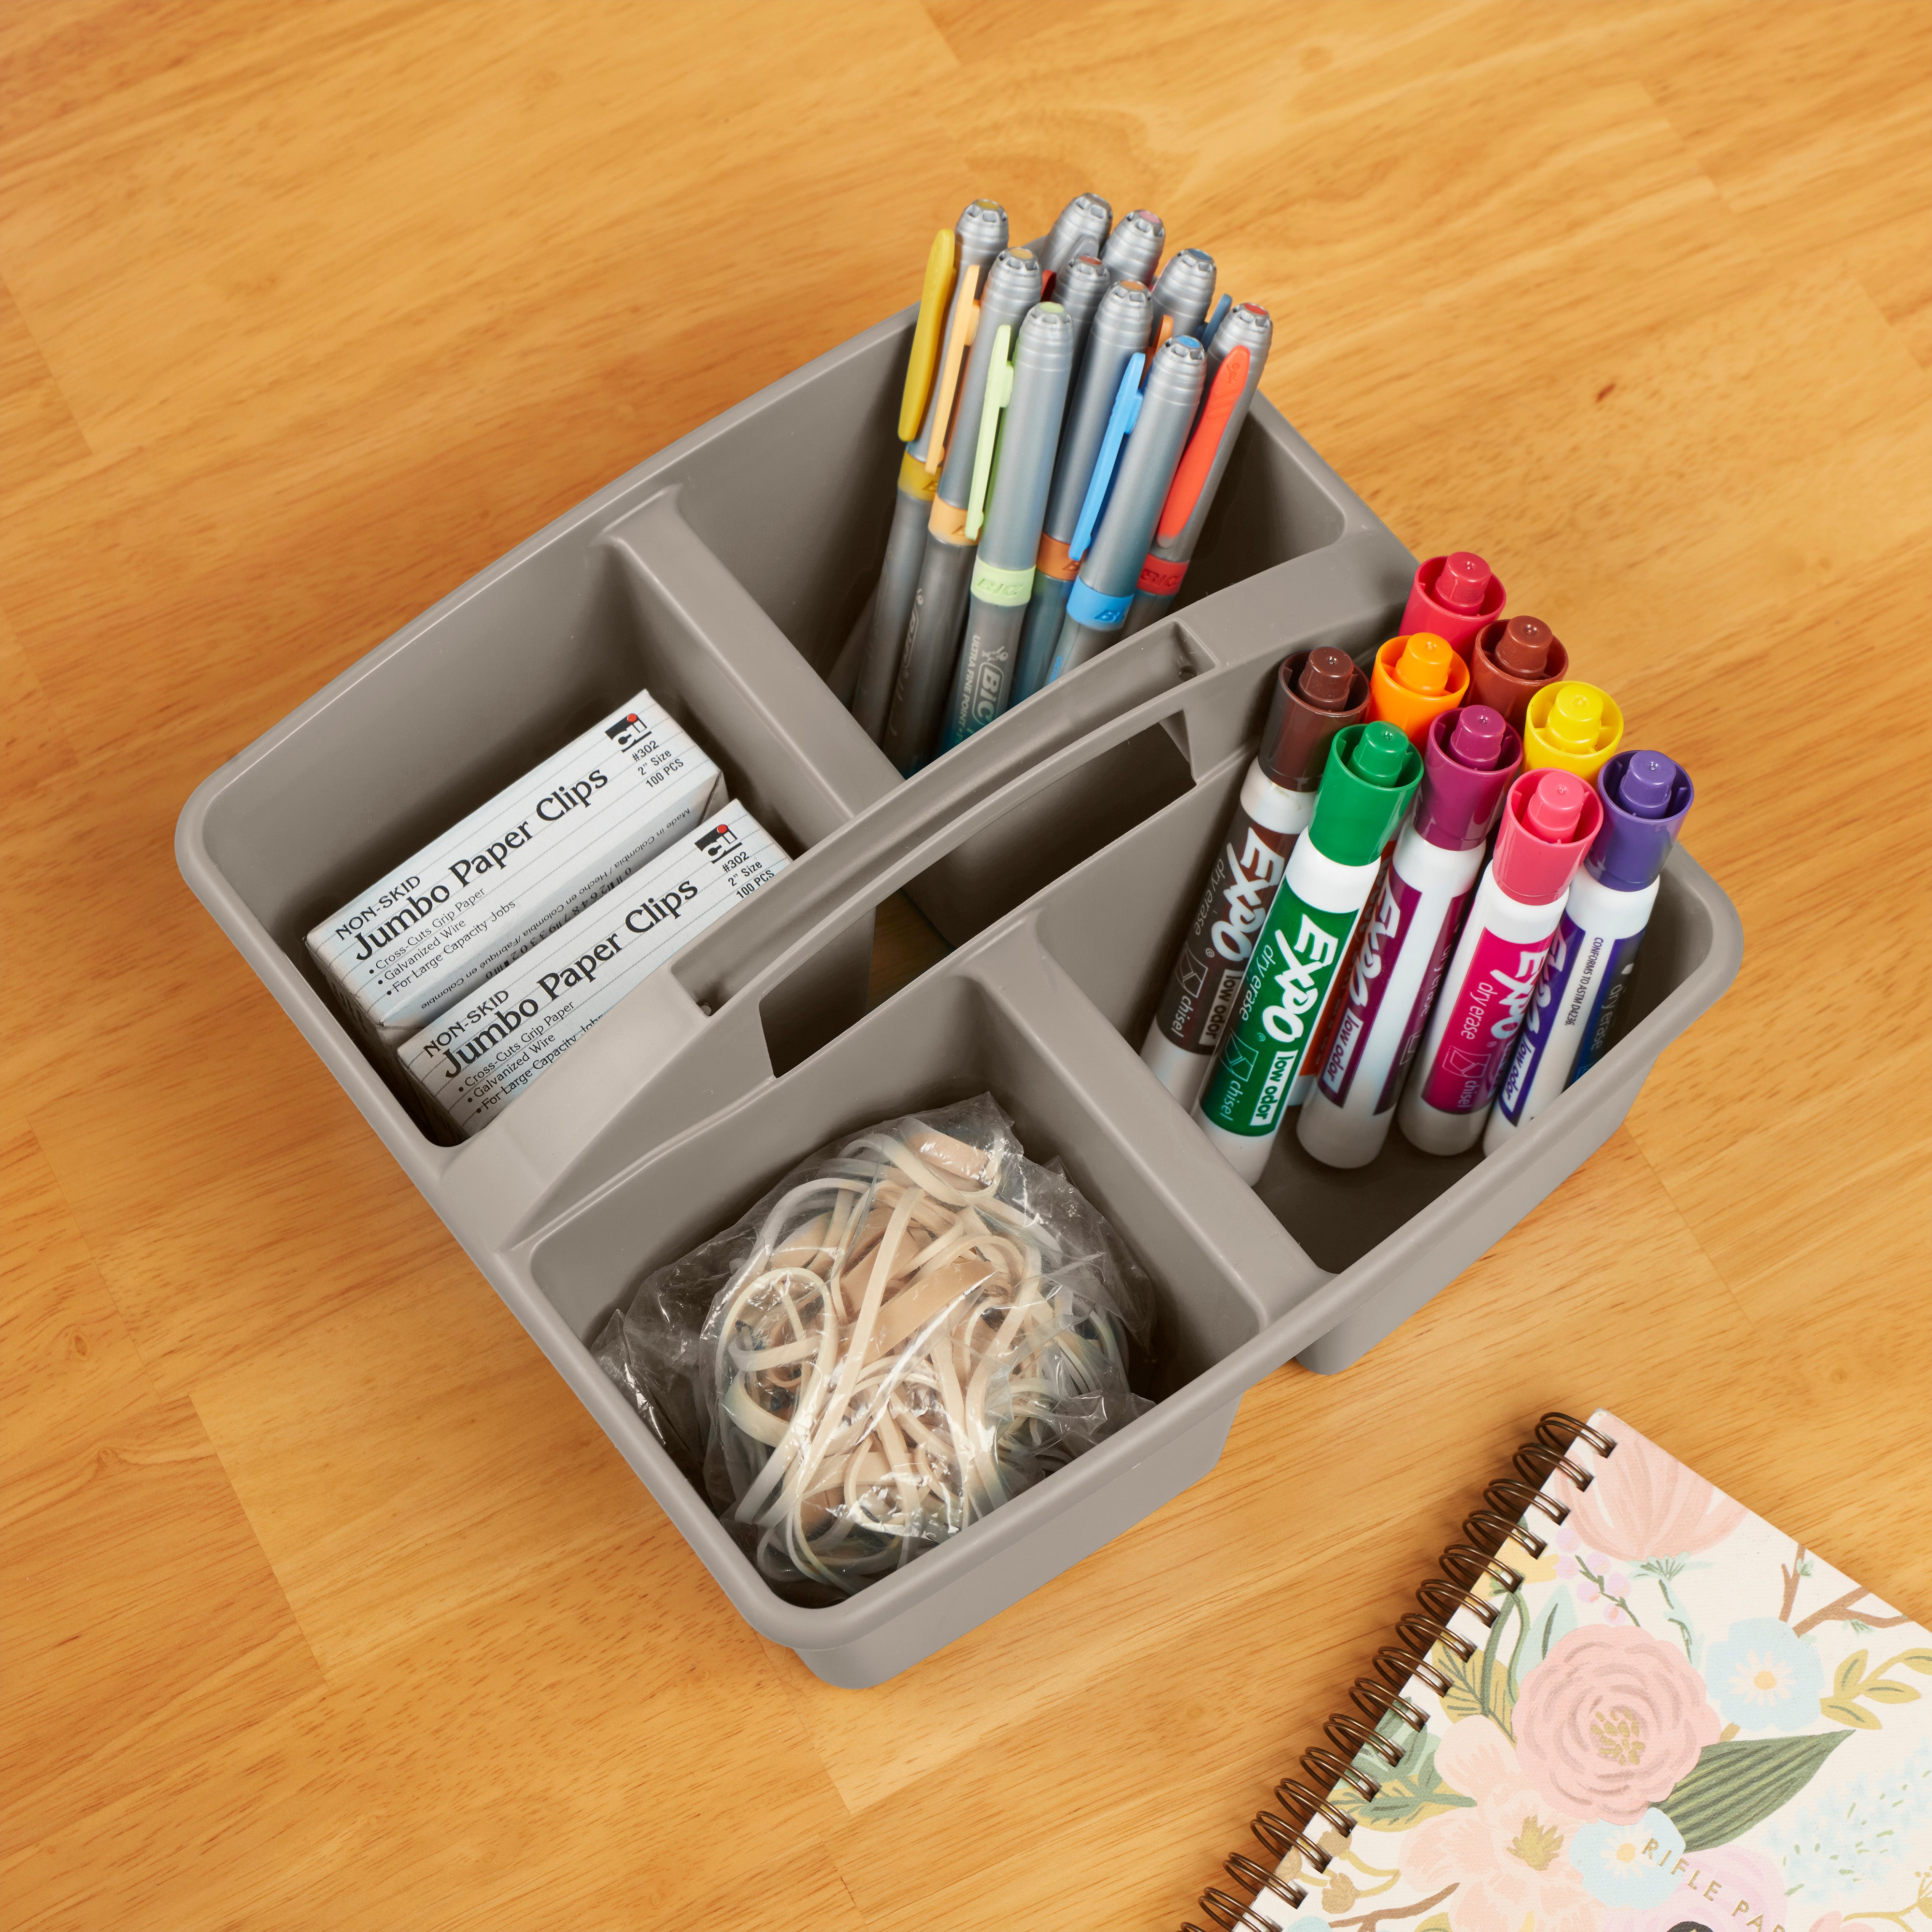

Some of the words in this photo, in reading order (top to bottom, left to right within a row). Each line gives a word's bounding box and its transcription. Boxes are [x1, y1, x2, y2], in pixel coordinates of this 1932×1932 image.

[968, 635, 981, 668] ULTRA
[964, 669, 974, 694] FINE
[958, 694, 971, 728] POINT
[632, 741, 659, 762] #302
[651, 751, 671, 766] Size
[646, 773, 664, 787] 100
[663, 759, 683, 775] PCS
[656, 828, 665, 836] in
[667, 808, 690, 828] Made
[354, 885, 450, 960] Jumbo
[448, 821, 533, 887] Paper
[536, 769, 608, 821] Clips
[614, 836, 654, 868] Colombia
[722, 852, 749, 872] #302
[579, 871, 608, 894] Hecho
[736, 883, 754, 898] 100
[753, 870, 774, 886] PCS
[741, 862, 762, 877] Size
[1211, 859, 1225, 891] dry
[335, 876, 420, 940] NON-SKID
[566, 895, 577, 904] en
[1211, 827, 1285, 961] EXPO
[376, 928, 432, 969] Cross-Cuts
[432, 911, 455, 928] Grip
[455, 889, 484, 912] Paper
[523, 905, 564, 937] Colombia
[1194, 890, 1213, 935] erase
[384, 937, 440, 980] Galvanized
[440, 920, 466, 938] Wire
[392, 976, 411, 992] For
[412, 955, 443, 978] Large
[443, 921, 488, 954] Capacity
[490, 901, 515, 922] Jobs
[1256, 945, 1276, 978] dry
[1583, 937, 1604, 976] CONFORMS
[442, 999, 539, 1078] Jumbo
[537, 933, 622, 1001] Paper
[625, 881, 697, 933] Clips
[466, 968, 477, 978] en
[1219, 975, 1242, 1002] low
[1262, 913, 1338, 1043] EXPO
[1580, 975, 1591, 985] TO
[421, 978, 464, 1009] Colombie
[1239, 975, 1261, 1021] erase
[1470, 982, 1498, 1007] dry
[1490, 948, 1548, 1039] EXPO
[1573, 984, 1587, 1004] ASTM
[1602, 984, 1625, 1009] dry
[423, 990, 509, 1058] NON-SKID
[1171, 995, 1193, 1037] chisel
[1206, 1005, 1226, 1038] odor
[1340, 1015, 1360, 1046] low
[1461, 1006, 1484, 1040] erase
[1564, 1004, 1580, 1026] D4236.
[1591, 1012, 1612, 1051] erase
[465, 1043, 520, 1086] Cross-Cuts
[521, 1024, 544, 1043] Grip
[543, 1002, 574, 1026] Paper
[1517, 1039, 1532, 1068] low
[474, 1052, 530, 1097] Galvanized
[529, 1035, 555, 1053] Wire
[481, 1093, 501, 1110] For
[501, 1069, 532, 1094] Large
[533, 1036, 576, 1069] Capacity
[1270, 1056, 1294, 1082] low
[1327, 1044, 1344, 1082] odor
[1457, 1080, 1479, 1108] chisel
[1506, 1066, 1519, 1100] odor
[1220, 1080, 1243, 1121] chisel
[1256, 1086, 1278, 1120] odor
[1641, 1837, 1721, 1901] RIFLE
